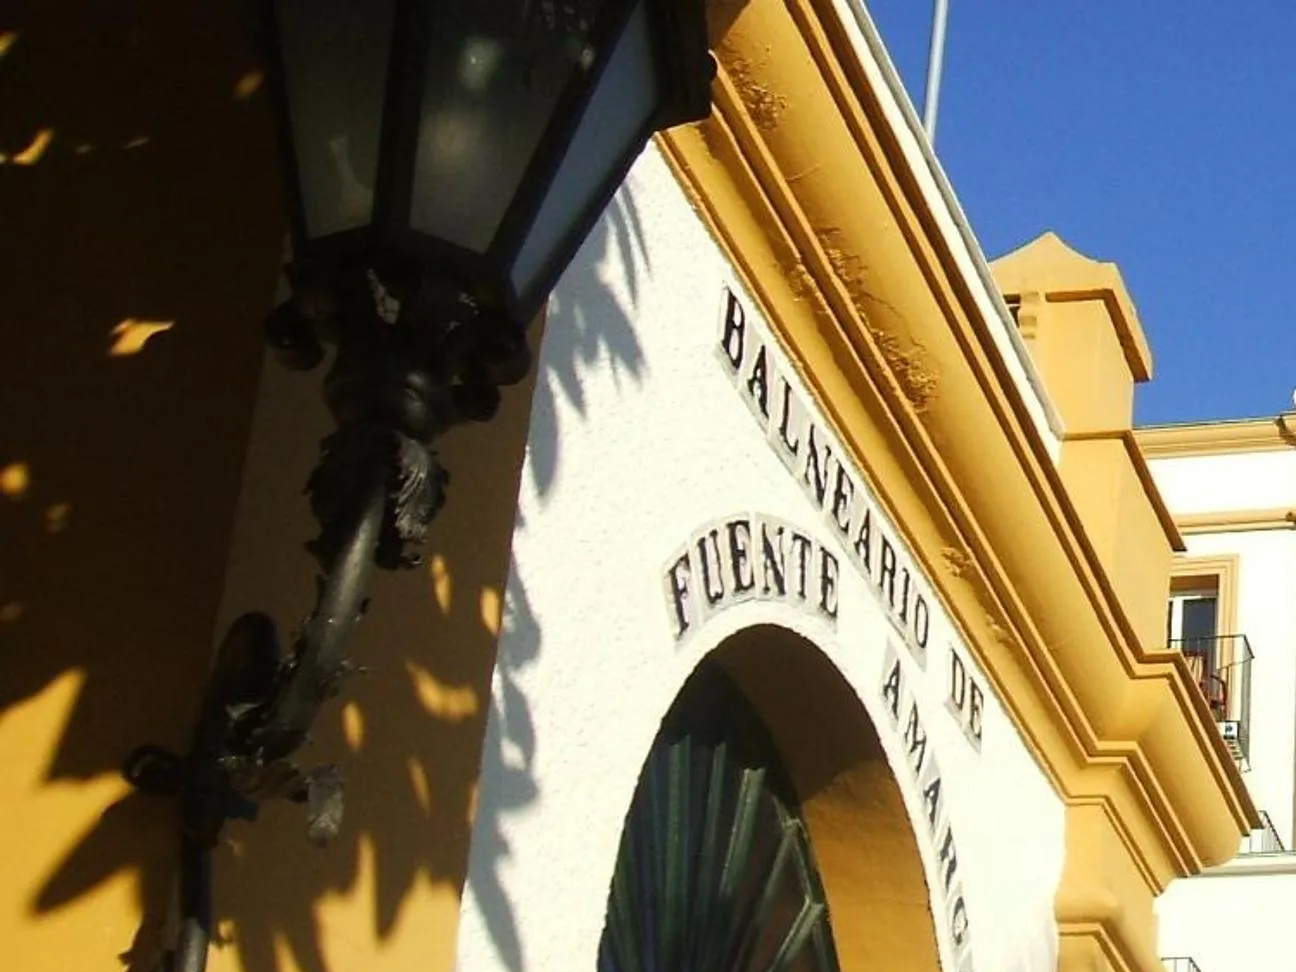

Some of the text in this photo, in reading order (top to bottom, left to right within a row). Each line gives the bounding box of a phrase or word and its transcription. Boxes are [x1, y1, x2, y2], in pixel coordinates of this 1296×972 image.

[668, 518, 840, 638] FUENTE
[721, 282, 984, 740] BALNEARIO DE
